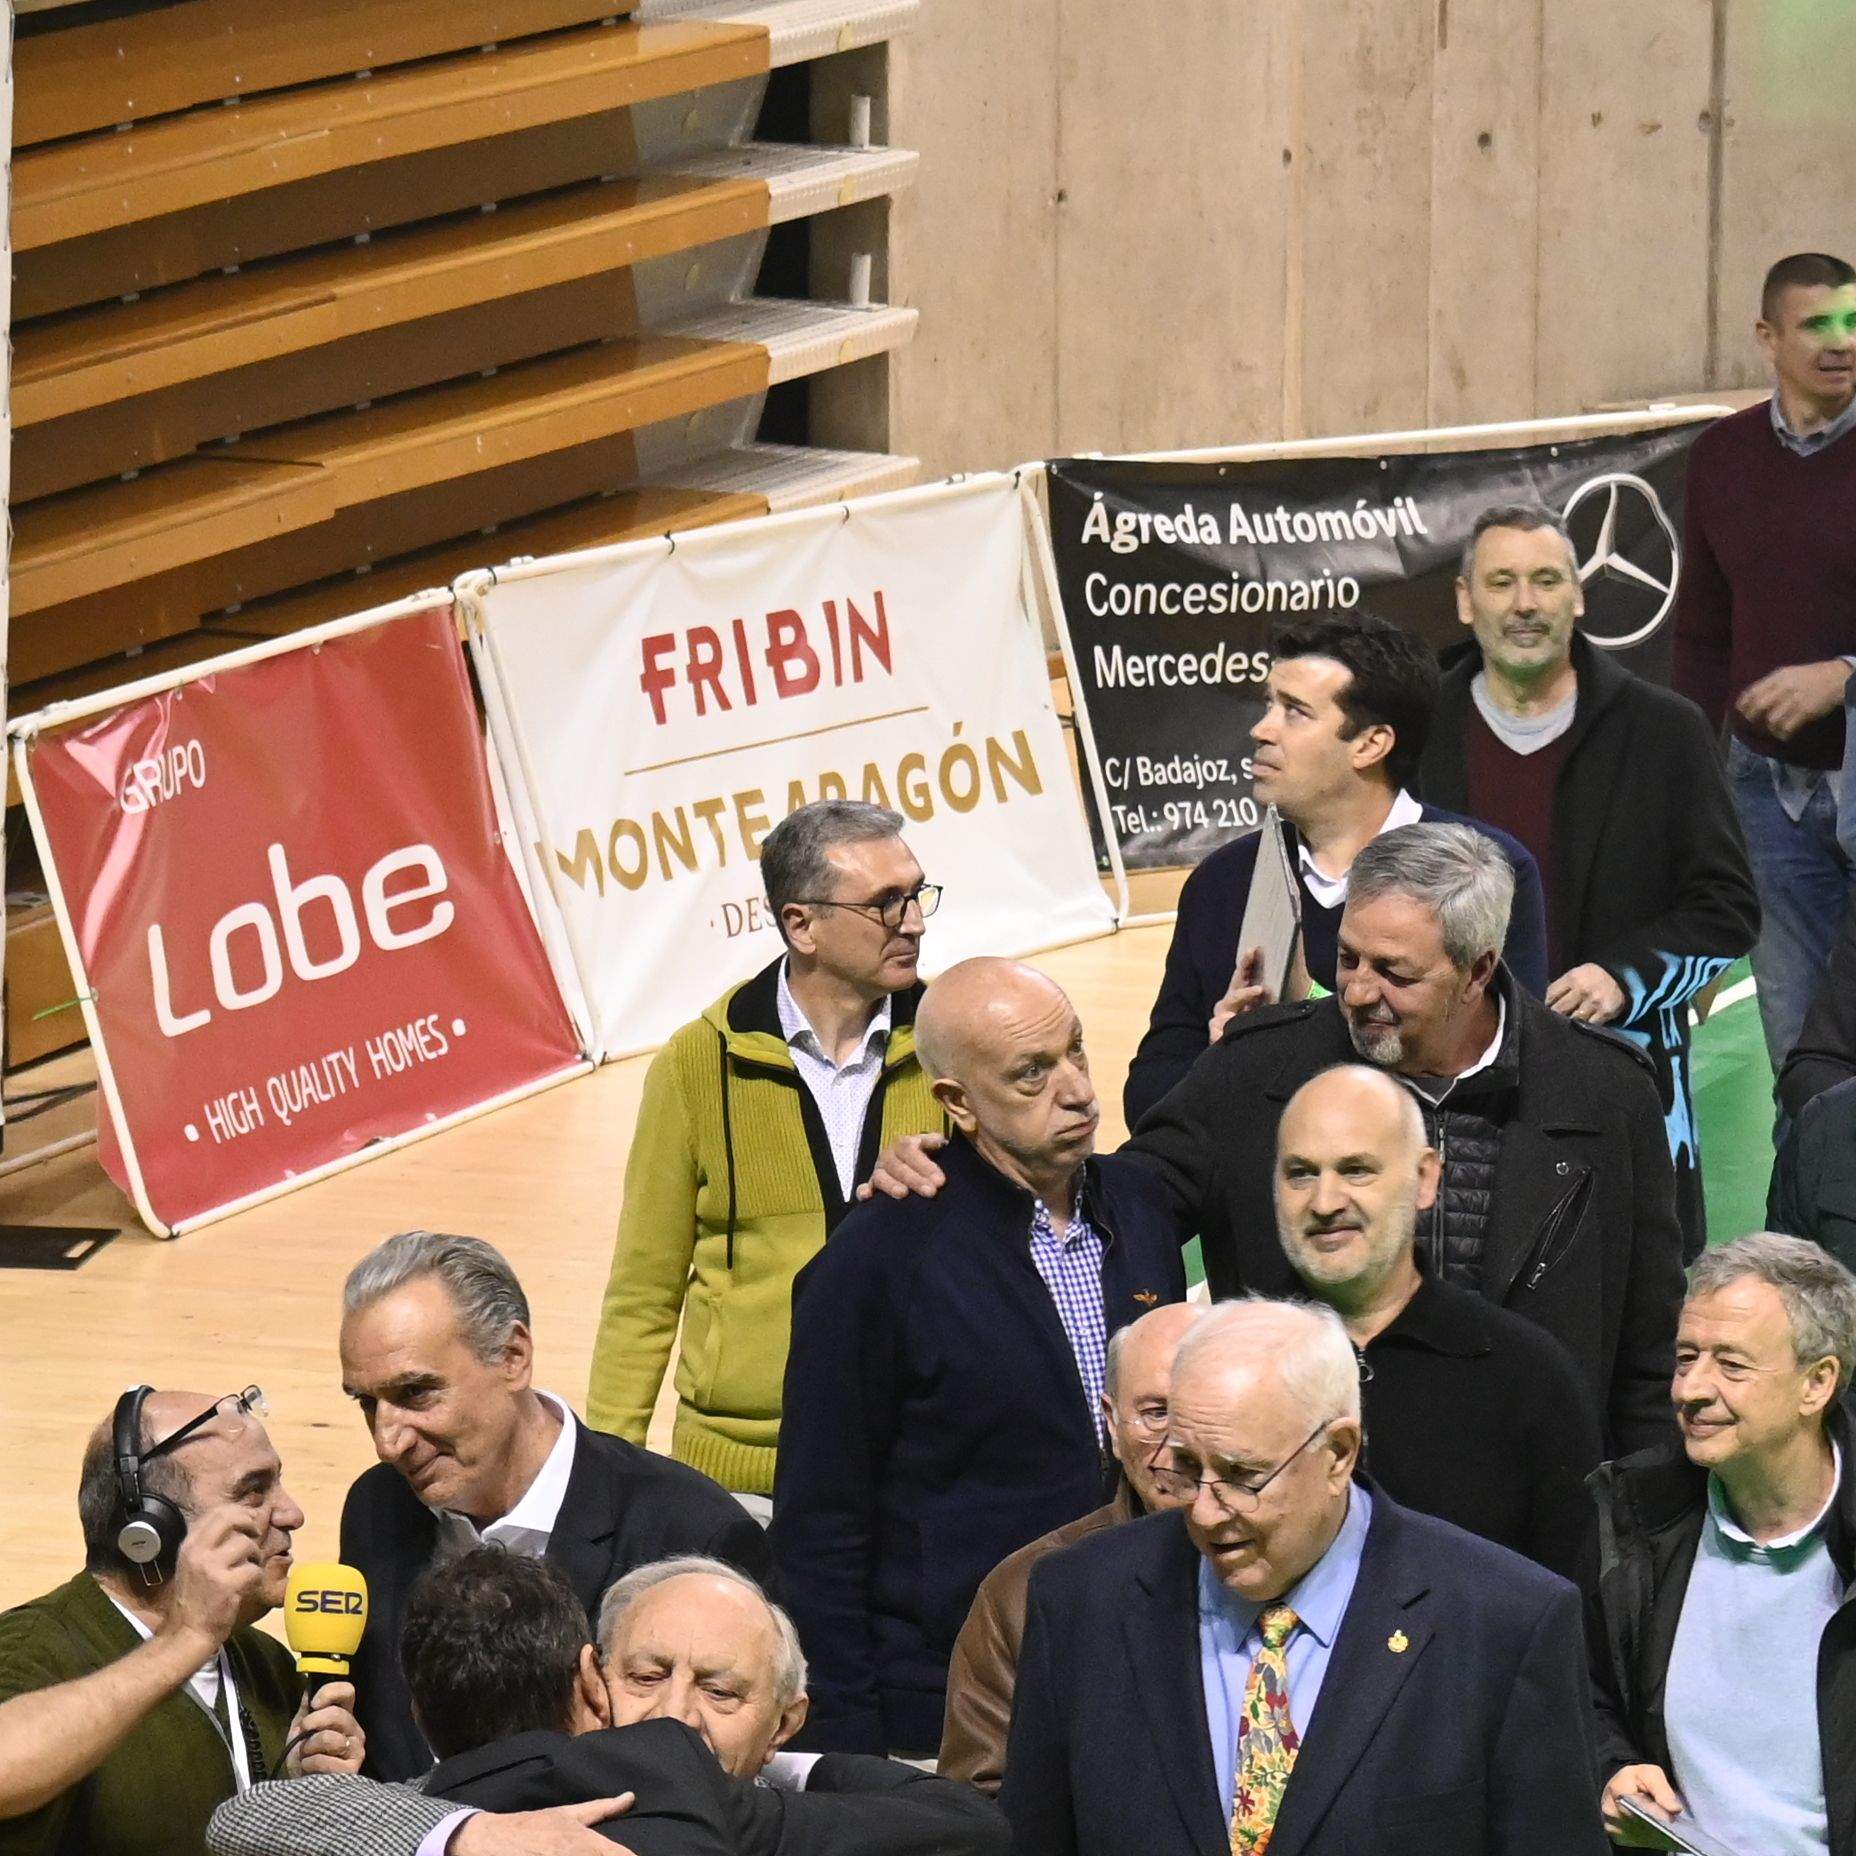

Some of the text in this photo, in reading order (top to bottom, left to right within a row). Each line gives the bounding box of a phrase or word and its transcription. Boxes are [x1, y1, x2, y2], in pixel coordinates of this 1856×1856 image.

[1081, 491, 1428, 554] Ágreda Automóvil
[1085, 568, 1360, 617] Concesionario
[640, 590, 893, 725] FRIBIN
[120, 739, 206, 814] GRUPO
[1105, 757, 1131, 790] C/
[1136, 753, 1238, 790] Badajoz,
[1163, 801, 1209, 830] 974
[1212, 797, 1258, 827] 210
[147, 843, 455, 1038] Lobe
[204, 1014, 448, 1144] HIGH QUALITY HOMES
[295, 1590, 363, 1615] SER
